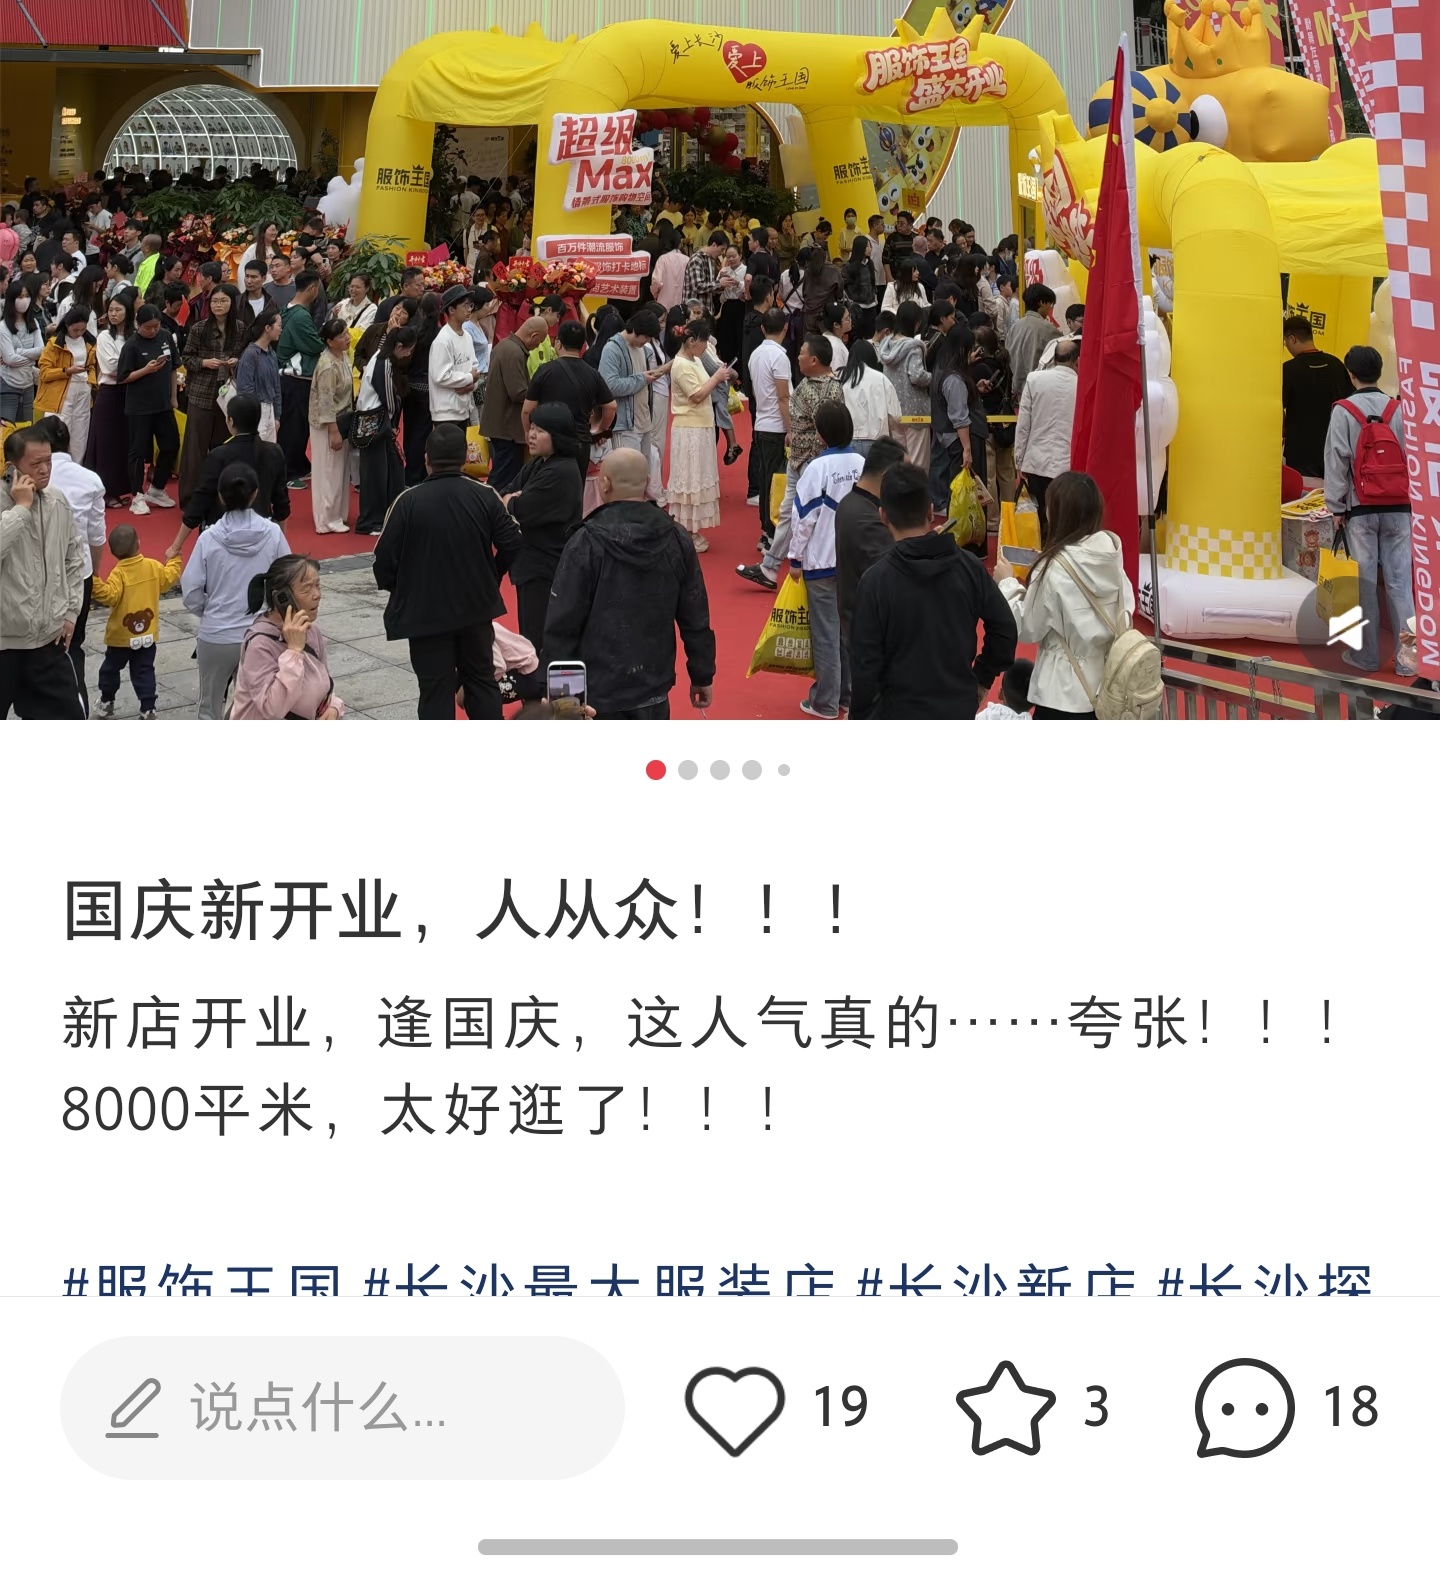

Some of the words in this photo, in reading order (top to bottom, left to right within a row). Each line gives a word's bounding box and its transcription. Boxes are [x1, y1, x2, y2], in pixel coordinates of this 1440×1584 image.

[727, 45, 763, 77] 爱上
[866, 37, 970, 90] 服饰王国
[909, 63, 1006, 112] 盛大开业
[557, 113, 634, 161] 超级
[576, 158, 653, 193] Max
[833, 156, 872, 181] 服饰王
[556, 241, 624, 254] 百万件潮流服饰
[596, 260, 647, 273] 服饰打卡地标
[591, 283, 637, 294] 尚艺术装置
